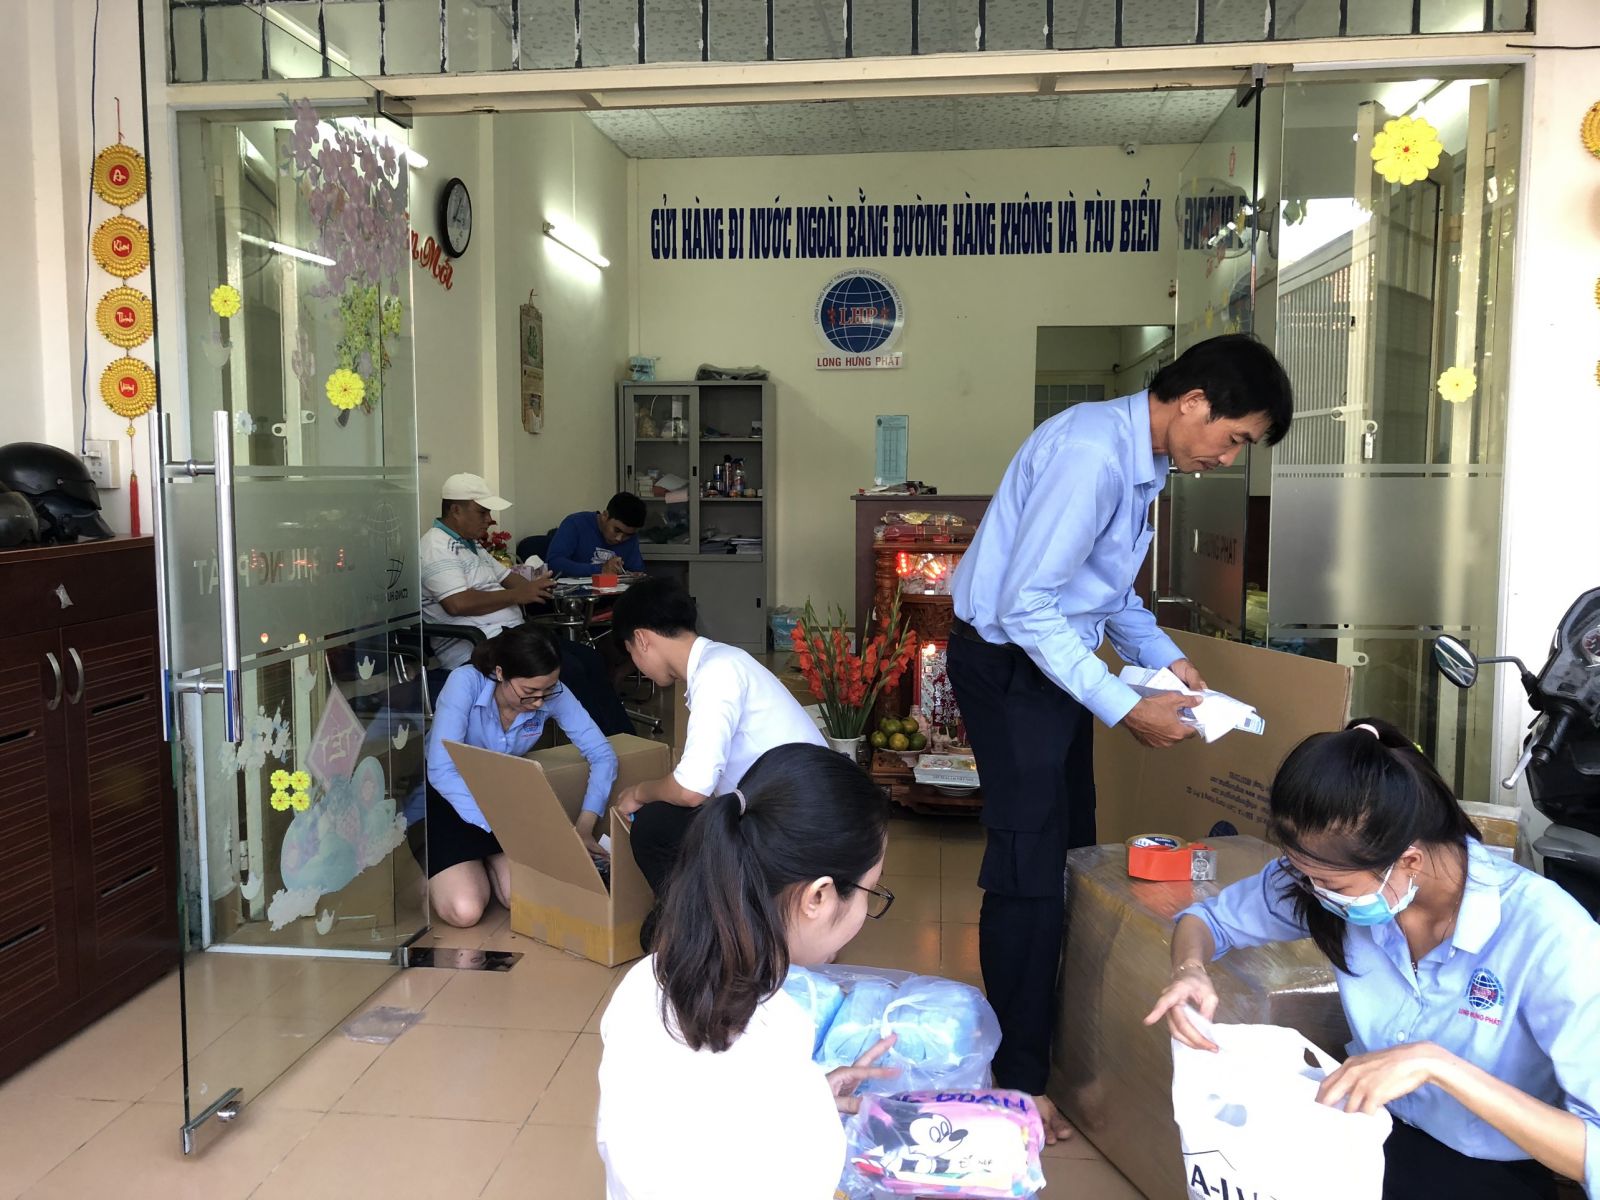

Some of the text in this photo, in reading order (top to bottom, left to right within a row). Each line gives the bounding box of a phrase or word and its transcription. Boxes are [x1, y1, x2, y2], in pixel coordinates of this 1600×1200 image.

[651, 193, 677, 260] GỬI
[681, 195, 724, 259] HÀNG
[728, 207, 744, 259] ĐI
[749, 194, 792, 260] NƯỚC
[796, 194, 842, 258] NGOÀI
[846, 186, 888, 258] BẰNG
[893, 193, 948, 257] ĐƯỜNG
[952, 191, 996, 256] HÀNG
[999, 191, 1053, 255] KHÔNG
[1058, 189, 1078, 254] VÀ
[1083, 188, 1116, 254] TÀU
[1119, 178, 1162, 253] BIỂN
[839, 306, 878, 325] LHP
[817, 357, 842, 367] LONG
